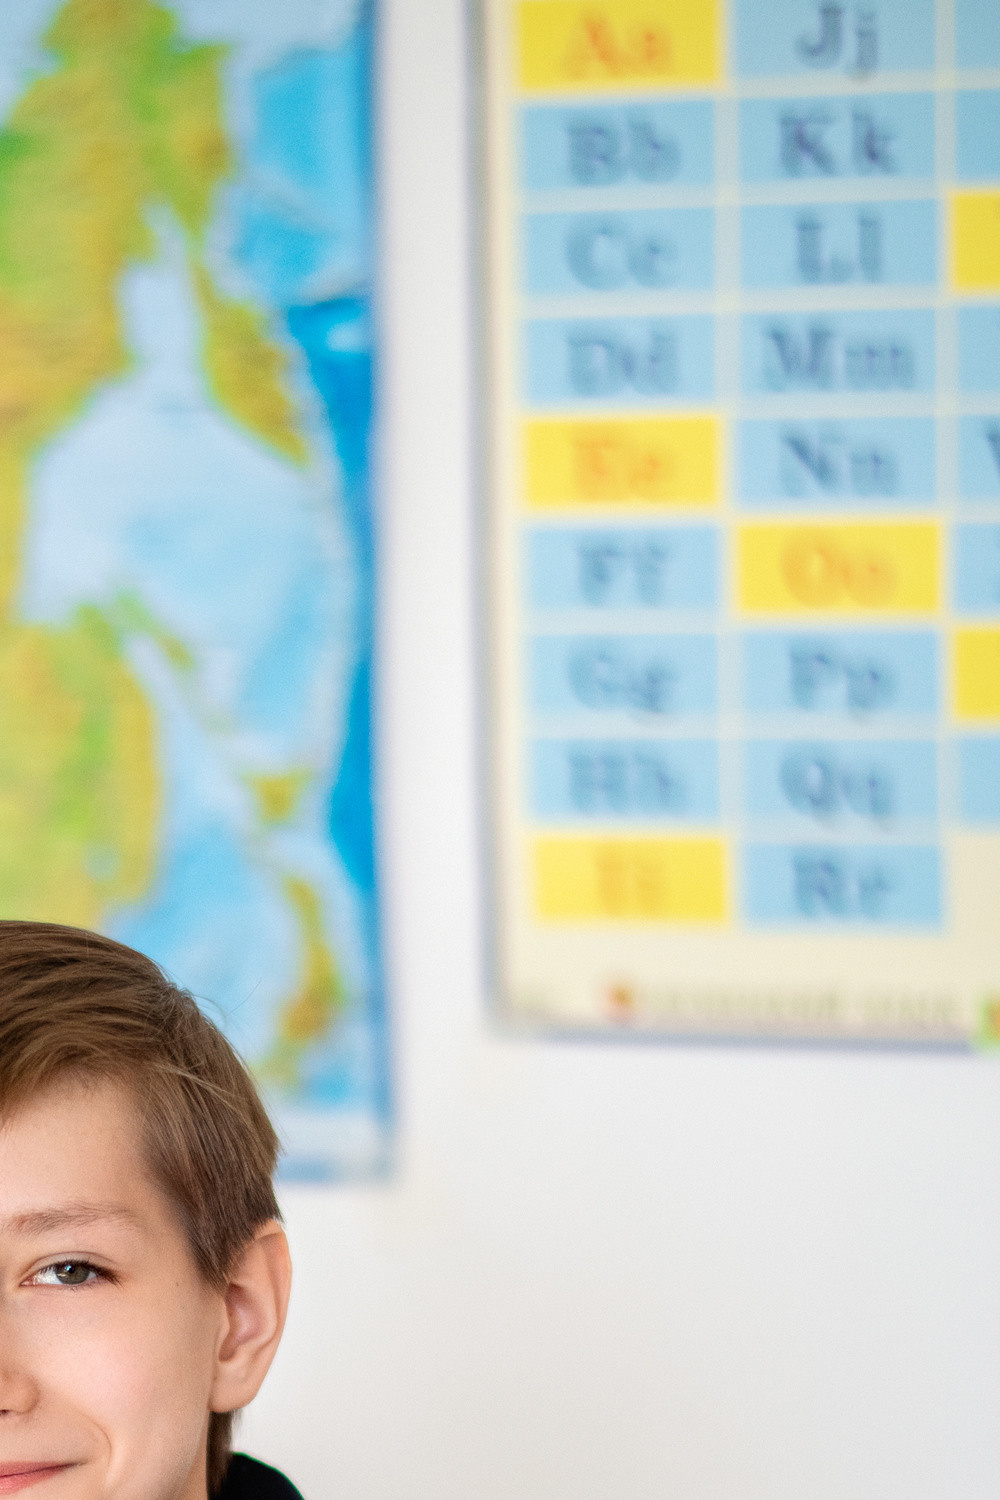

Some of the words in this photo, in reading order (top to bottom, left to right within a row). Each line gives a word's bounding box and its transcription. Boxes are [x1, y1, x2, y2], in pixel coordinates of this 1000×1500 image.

[796, 2, 878, 82] Jj
[566, 108, 682, 187] Bb
[780, 105, 896, 178] Kk
[565, 214, 678, 291] Cc
[795, 209, 883, 285] Ll
[566, 321, 680, 398] Dd
[763, 318, 916, 393] Mm
[781, 424, 898, 498] Nn
[576, 535, 675, 605] Ff
[779, 530, 899, 608] Oo
[566, 638, 680, 727] Gg
[789, 637, 899, 726] Pp
[567, 741, 687, 815] Hh
[779, 741, 898, 832] Qq
[790, 848, 894, 919] Rr
